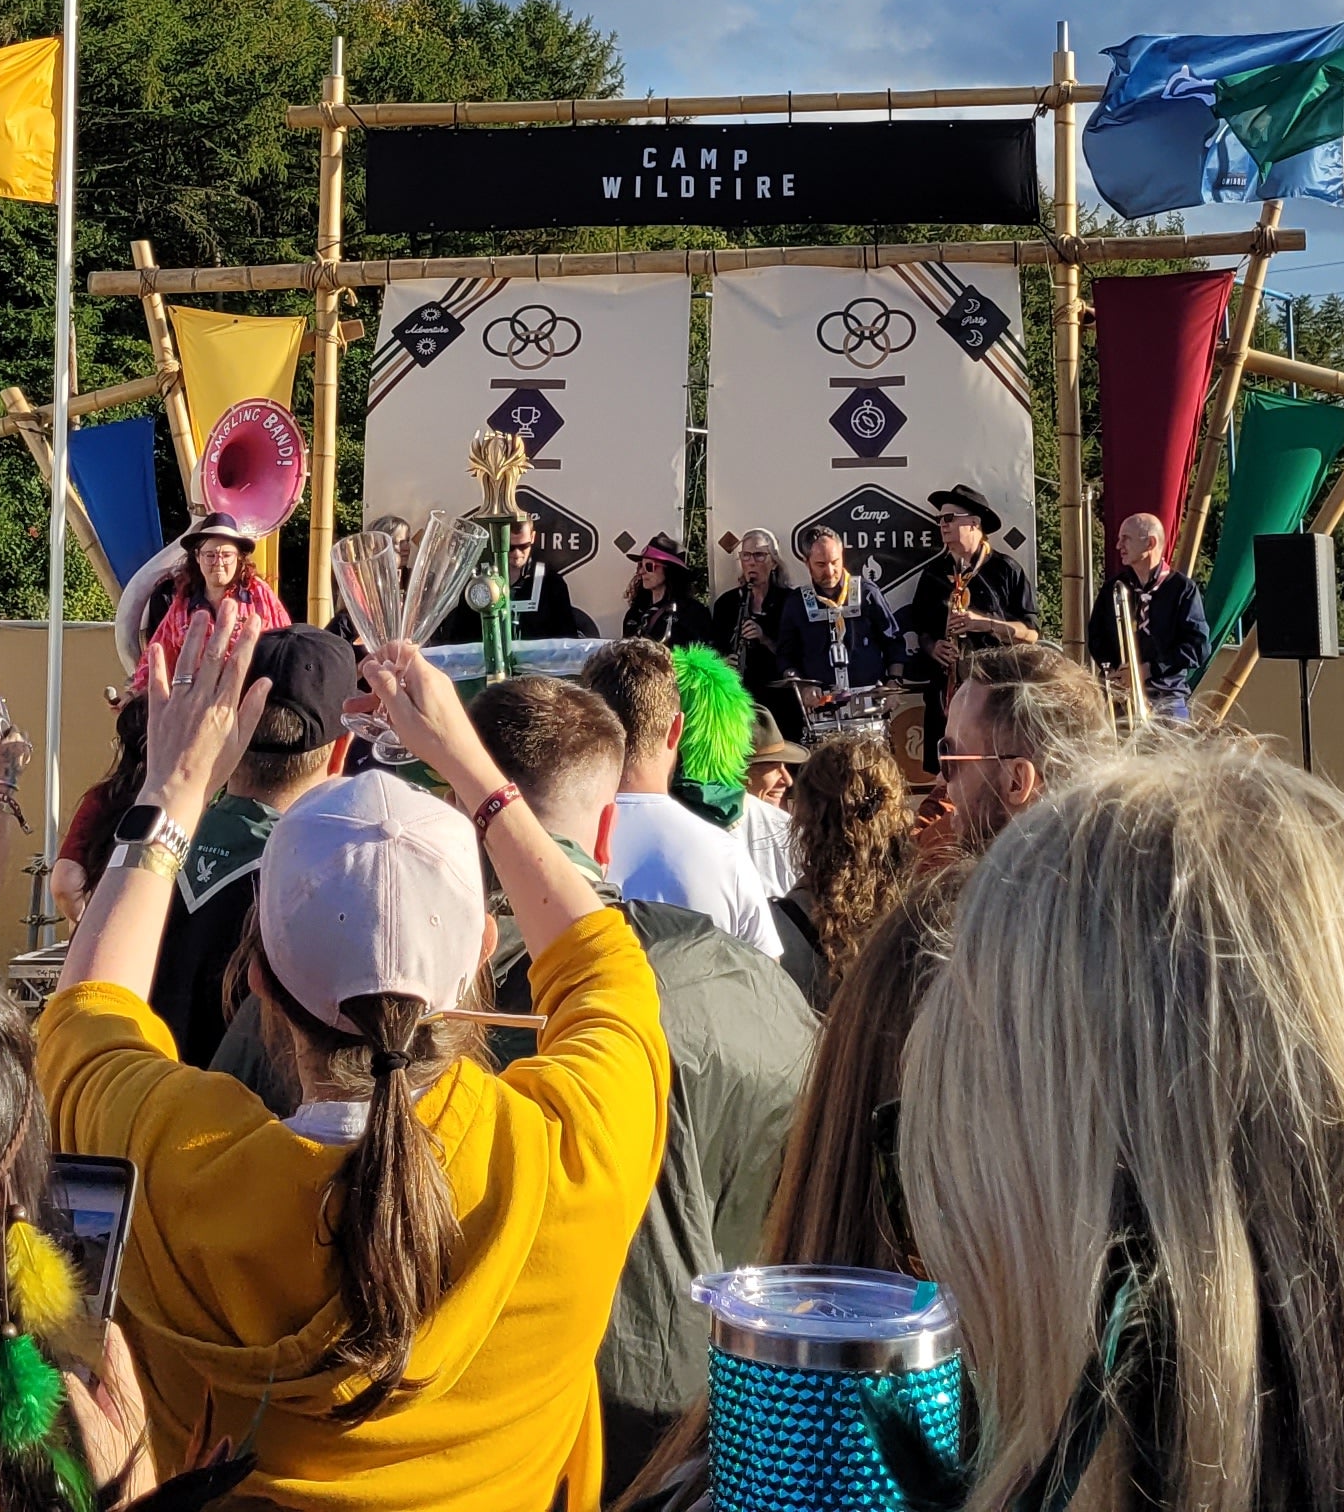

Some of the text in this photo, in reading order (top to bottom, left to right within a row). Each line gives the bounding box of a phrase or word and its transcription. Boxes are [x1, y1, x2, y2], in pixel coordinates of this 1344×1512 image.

[642, 147, 748, 171] CAMP
[602, 174, 795, 200] WILDFIRE
[405, 323, 449, 334] Adventure
[960, 315, 987, 327] Party
[262, 412, 294, 466] BAND!
[850, 504, 890, 524] Camp
[843, 530, 932, 549] LDFIRE
